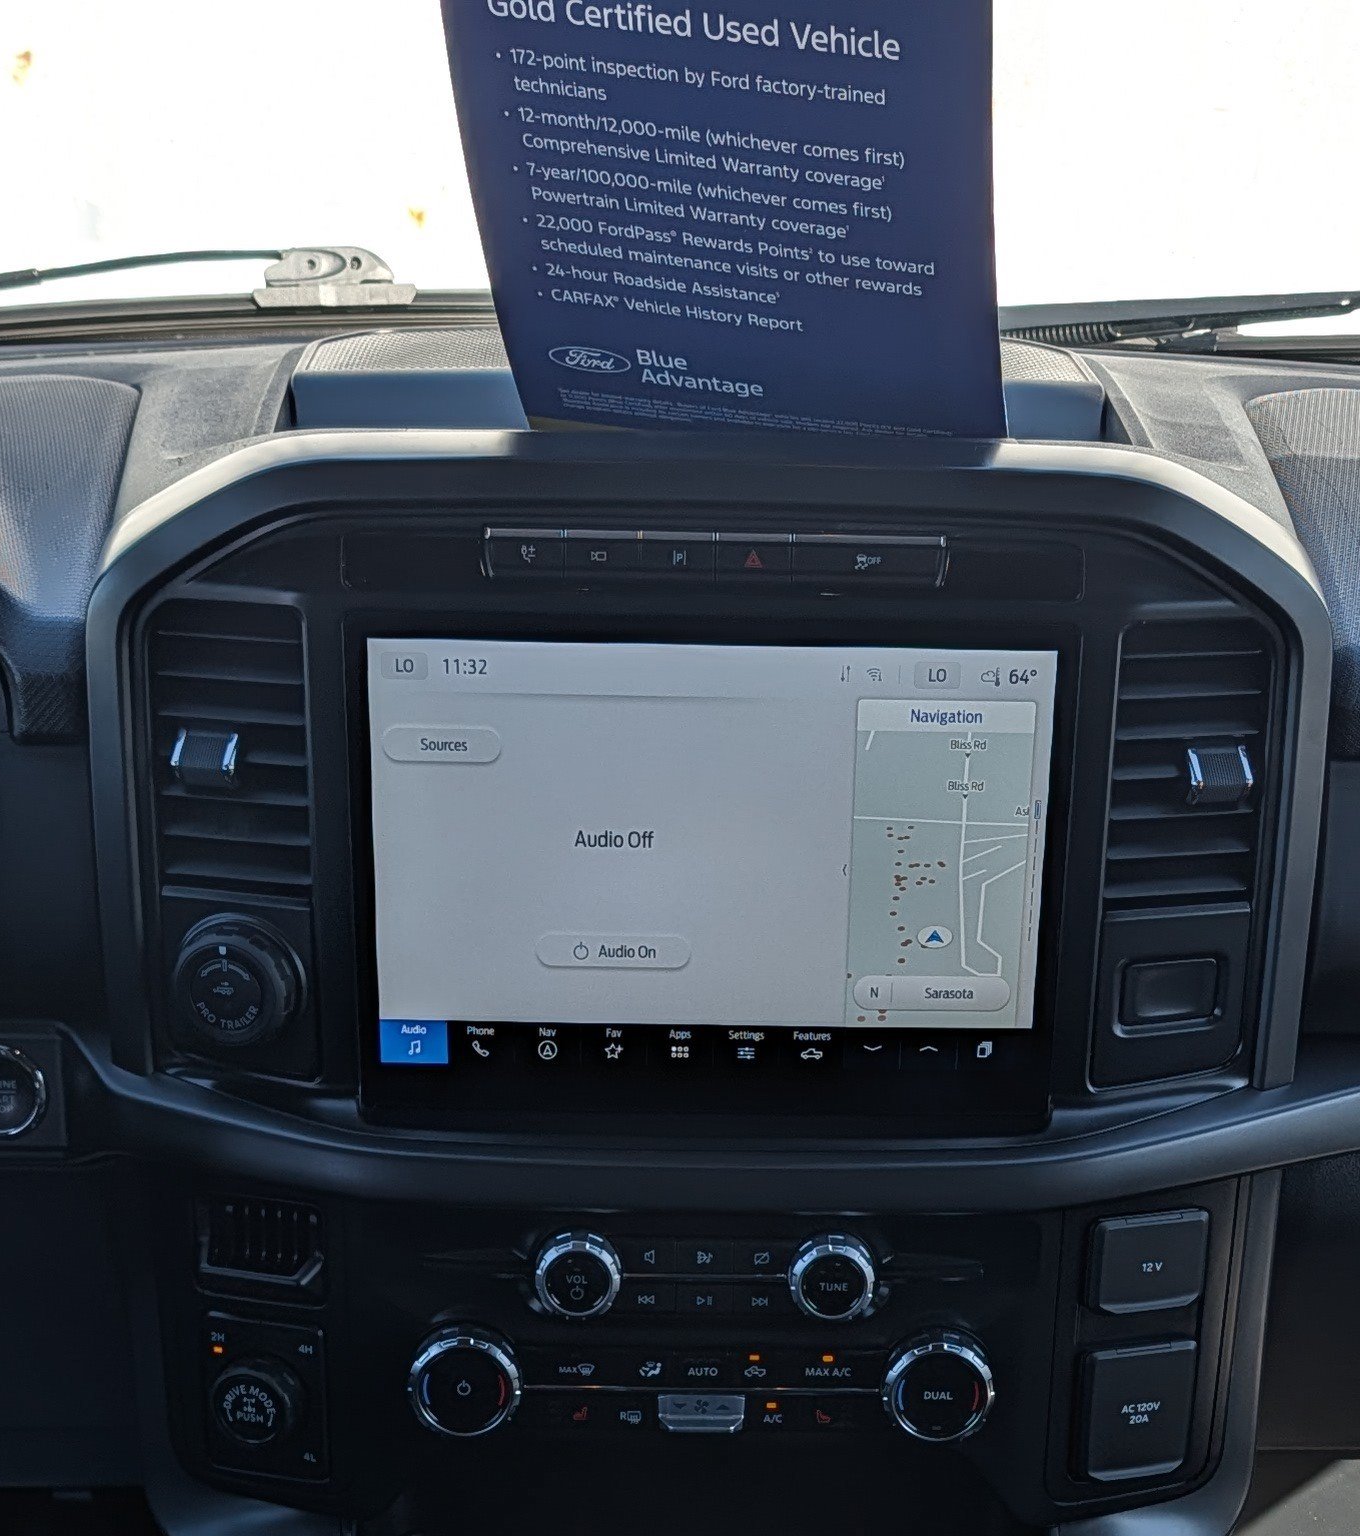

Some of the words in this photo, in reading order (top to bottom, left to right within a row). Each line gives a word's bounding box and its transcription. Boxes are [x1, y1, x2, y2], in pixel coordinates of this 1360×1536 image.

[488, 0, 555, 23] Gold
[566, 0, 691, 38] Certified
[702, 12, 779, 47] Used
[790, 21, 901, 61] Vehicle
[509, 48, 586, 72] 172-point
[591, 56, 679, 83] inspection
[684, 67, 705, 88] by
[711, 71, 750, 90] Ford
[756, 75, 886, 105] factory-trained
[514, 75, 607, 101] technicians
[517, 107, 700, 142] 12-month/12,000-mile
[706, 129, 797, 154] (whichever
[803, 144, 859, 161] comes
[864, 147, 905, 169] first)
[522, 133, 650, 162] Comprehensive
[655, 148, 716, 170] Limited
[722, 156, 799, 182] Warranty
[526, 162, 692, 196] 7-year/100,000-mile
[697, 182, 787, 207] (whichever
[792, 196, 847, 215] comes
[852, 202, 892, 223] first)
[531, 186, 620, 210] Powertrain
[625, 197, 684, 218] Limited
[690, 206, 766, 231] Warranty
[536, 214, 593, 234] 22,000
[682, 231, 753, 254] Rewards
[818, 250, 835, 264] to
[841, 253, 871, 268] use
[876, 256, 935, 276] toward
[540, 238, 623, 260] scheduled
[628, 248, 731, 274] maintenance
[736, 262, 778, 280] visits
[783, 269, 799, 281] or
[806, 271, 850, 288] other
[855, 278, 923, 297] rewards
[545, 263, 608, 283] 24-hour
[613, 271, 687, 293] Roadside
[623, 297, 682, 317] Vehicle
[685, 304, 742, 326] History
[748, 313, 804, 332] Report
[565, 349, 615, 370] Ford
[636, 349, 688, 370] Blue
[641, 368, 764, 398] Advantage
[867, 556, 882, 566] OFF
[394, 659, 415, 674] LO
[442, 657, 489, 677] 11:32
[928, 668, 947, 684] LO
[1008, 668, 1038, 686] 64°
[910, 709, 983, 727] Navigation
[420, 737, 468, 755] Sources
[950, 739, 972, 750] Bliss
[973, 740, 987, 750] Rd
[947, 781, 969, 791] Bliss
[971, 781, 985, 792] Rd
[574, 830, 624, 849] Audio
[627, 830, 655, 849] Off
[597, 944, 636, 960] Audio
[638, 944, 657, 960] On
[869, 986, 879, 999] N
[924, 986, 974, 1000] Sarasota
[196, 1001, 217, 1023] PRO
[220, 1005, 259, 1030] TRAILER
[400, 1024, 427, 1035] Audio
[466, 1025, 495, 1036] Phone
[538, 1027, 557, 1037] Nav
[605, 1027, 623, 1037] Fav
[668, 1029, 692, 1041] Apps
[728, 1029, 764, 1041] Settings
[793, 1030, 831, 1041] Features
[1142, 1262, 1153, 1272] 12
[1154, 1262, 1163, 1272] V
[565, 1274, 589, 1285] VOL
[819, 1282, 849, 1292] TUNE
[210, 1331, 225, 1342] 2H
[297, 1344, 313, 1355] 4H
[558, 1366, 577, 1375] MAX
[687, 1366, 719, 1377] AUTO
[805, 1366, 830, 1377] MAX
[831, 1366, 852, 1378] A/C
[223, 1384, 247, 1409] DRIVE
[249, 1386, 276, 1416] MODE
[923, 1391, 953, 1400] DUAL
[1121, 1404, 1136, 1415] AC
[1137, 1401, 1160, 1413] 120V
[236, 1411, 264, 1423] PUSH
[763, 1413, 784, 1424] A/C
[1129, 1413, 1150, 1425] 20A
[303, 1452, 317, 1463] 4L
